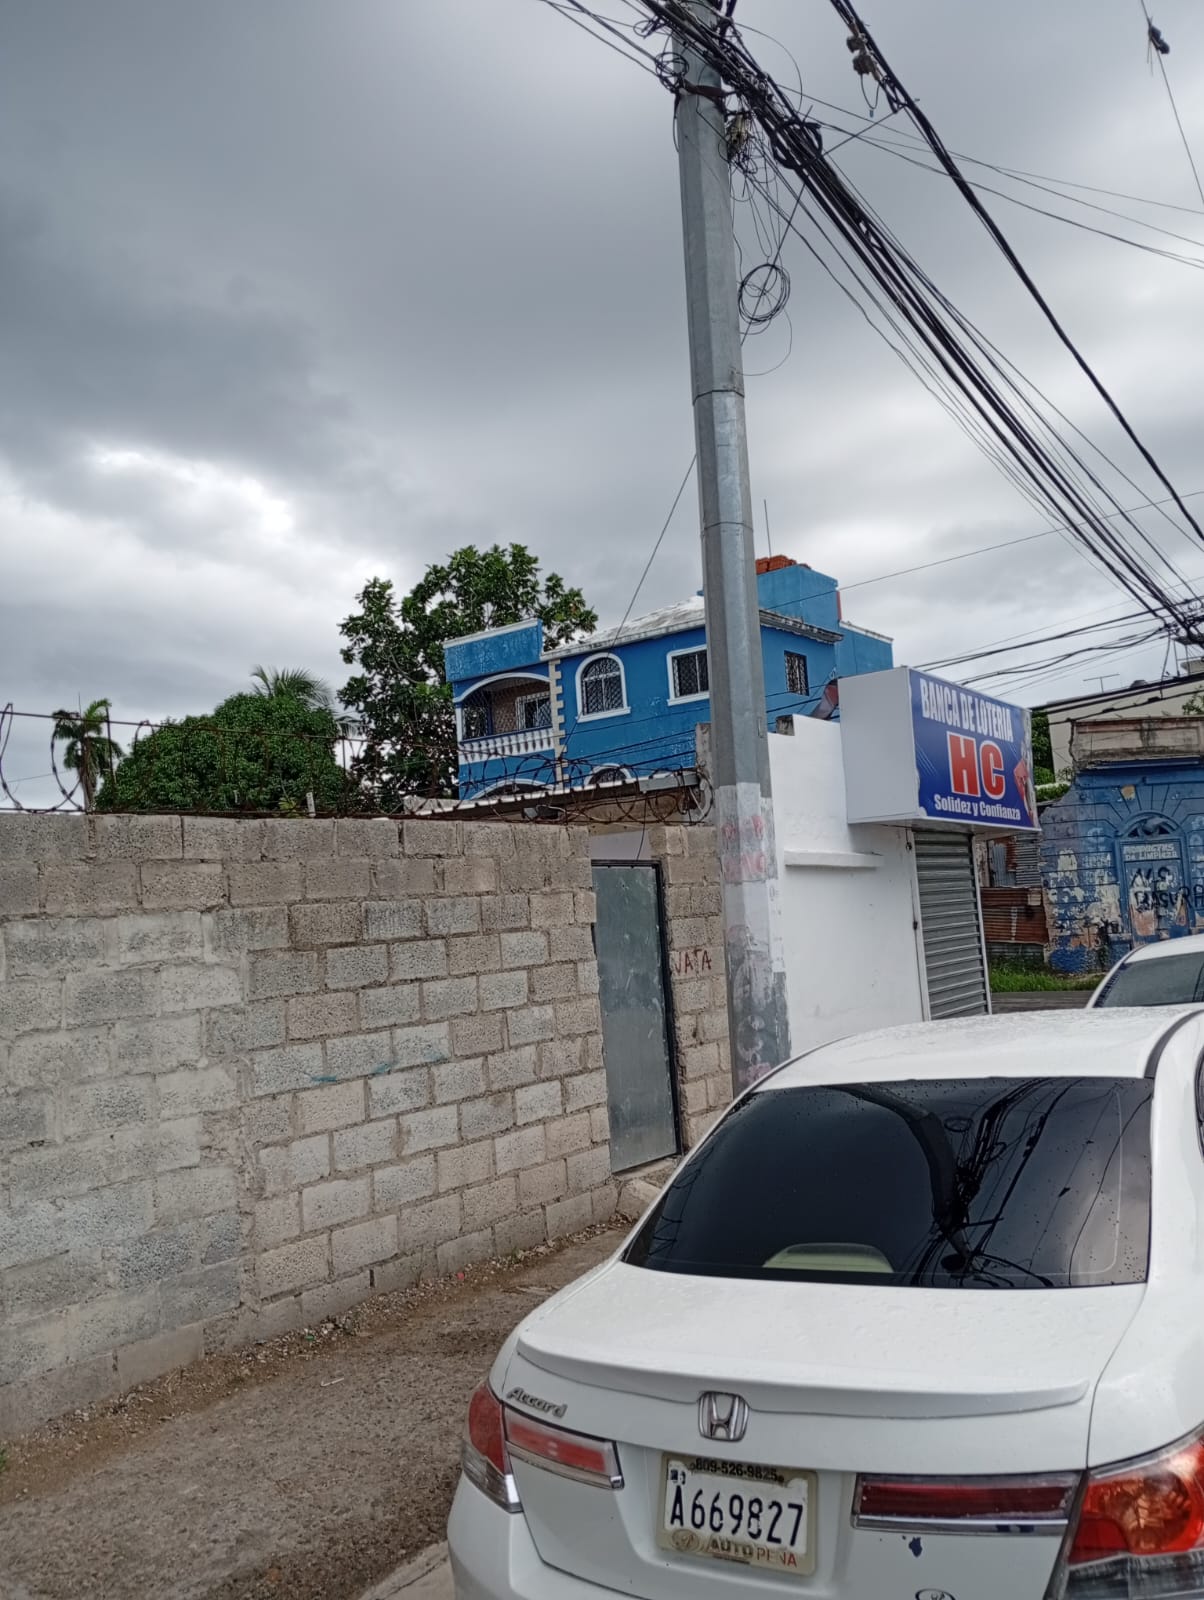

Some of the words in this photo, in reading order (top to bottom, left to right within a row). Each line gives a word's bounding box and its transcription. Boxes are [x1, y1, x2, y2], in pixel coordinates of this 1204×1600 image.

[920, 678, 960, 728] BANCA
[960, 693, 976, 732] DE
[974, 698, 1014, 742] LOTERIA
[946, 731, 1006, 800] HC
[934, 794, 972, 814] Solidez
[972, 803, 979, 817] y
[979, 801, 1021, 821] Confianza
[506, 1386, 568, 1418] Accord
[695, 1457, 778, 1482] 809-526-9825
[670, 1485, 803, 1546] A669827
